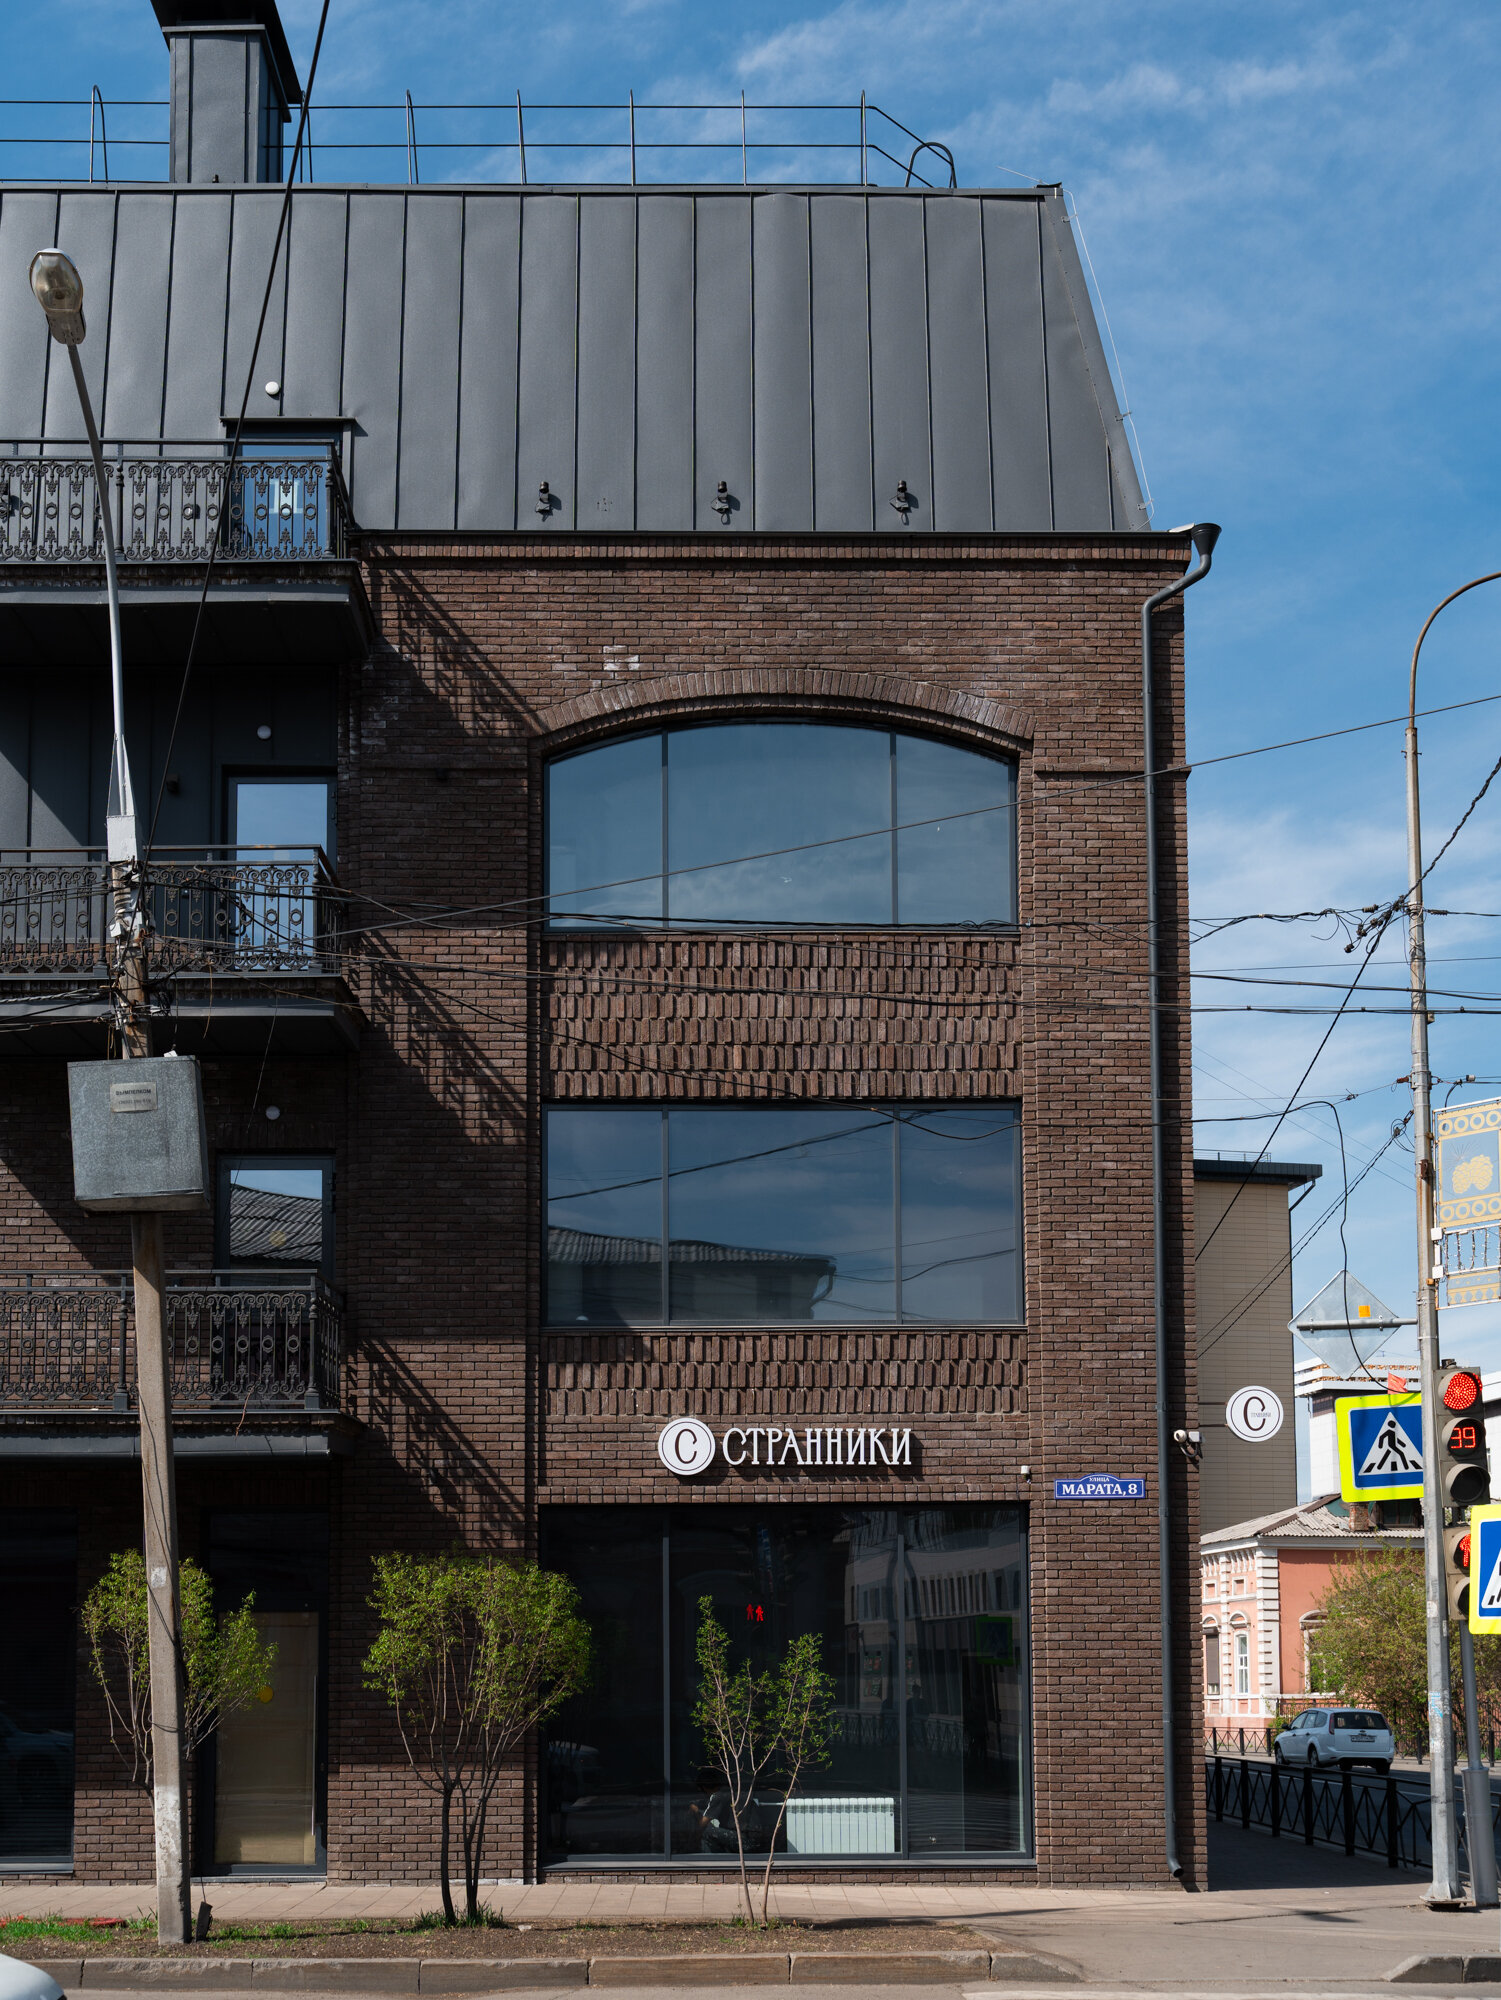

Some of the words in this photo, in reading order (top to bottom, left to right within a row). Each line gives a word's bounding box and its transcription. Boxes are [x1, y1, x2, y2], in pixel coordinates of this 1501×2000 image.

[674, 1428, 698, 1465] С
[722, 1427, 912, 1466] СТРАННИКИ
[1450, 1426, 1476, 1449] 39
